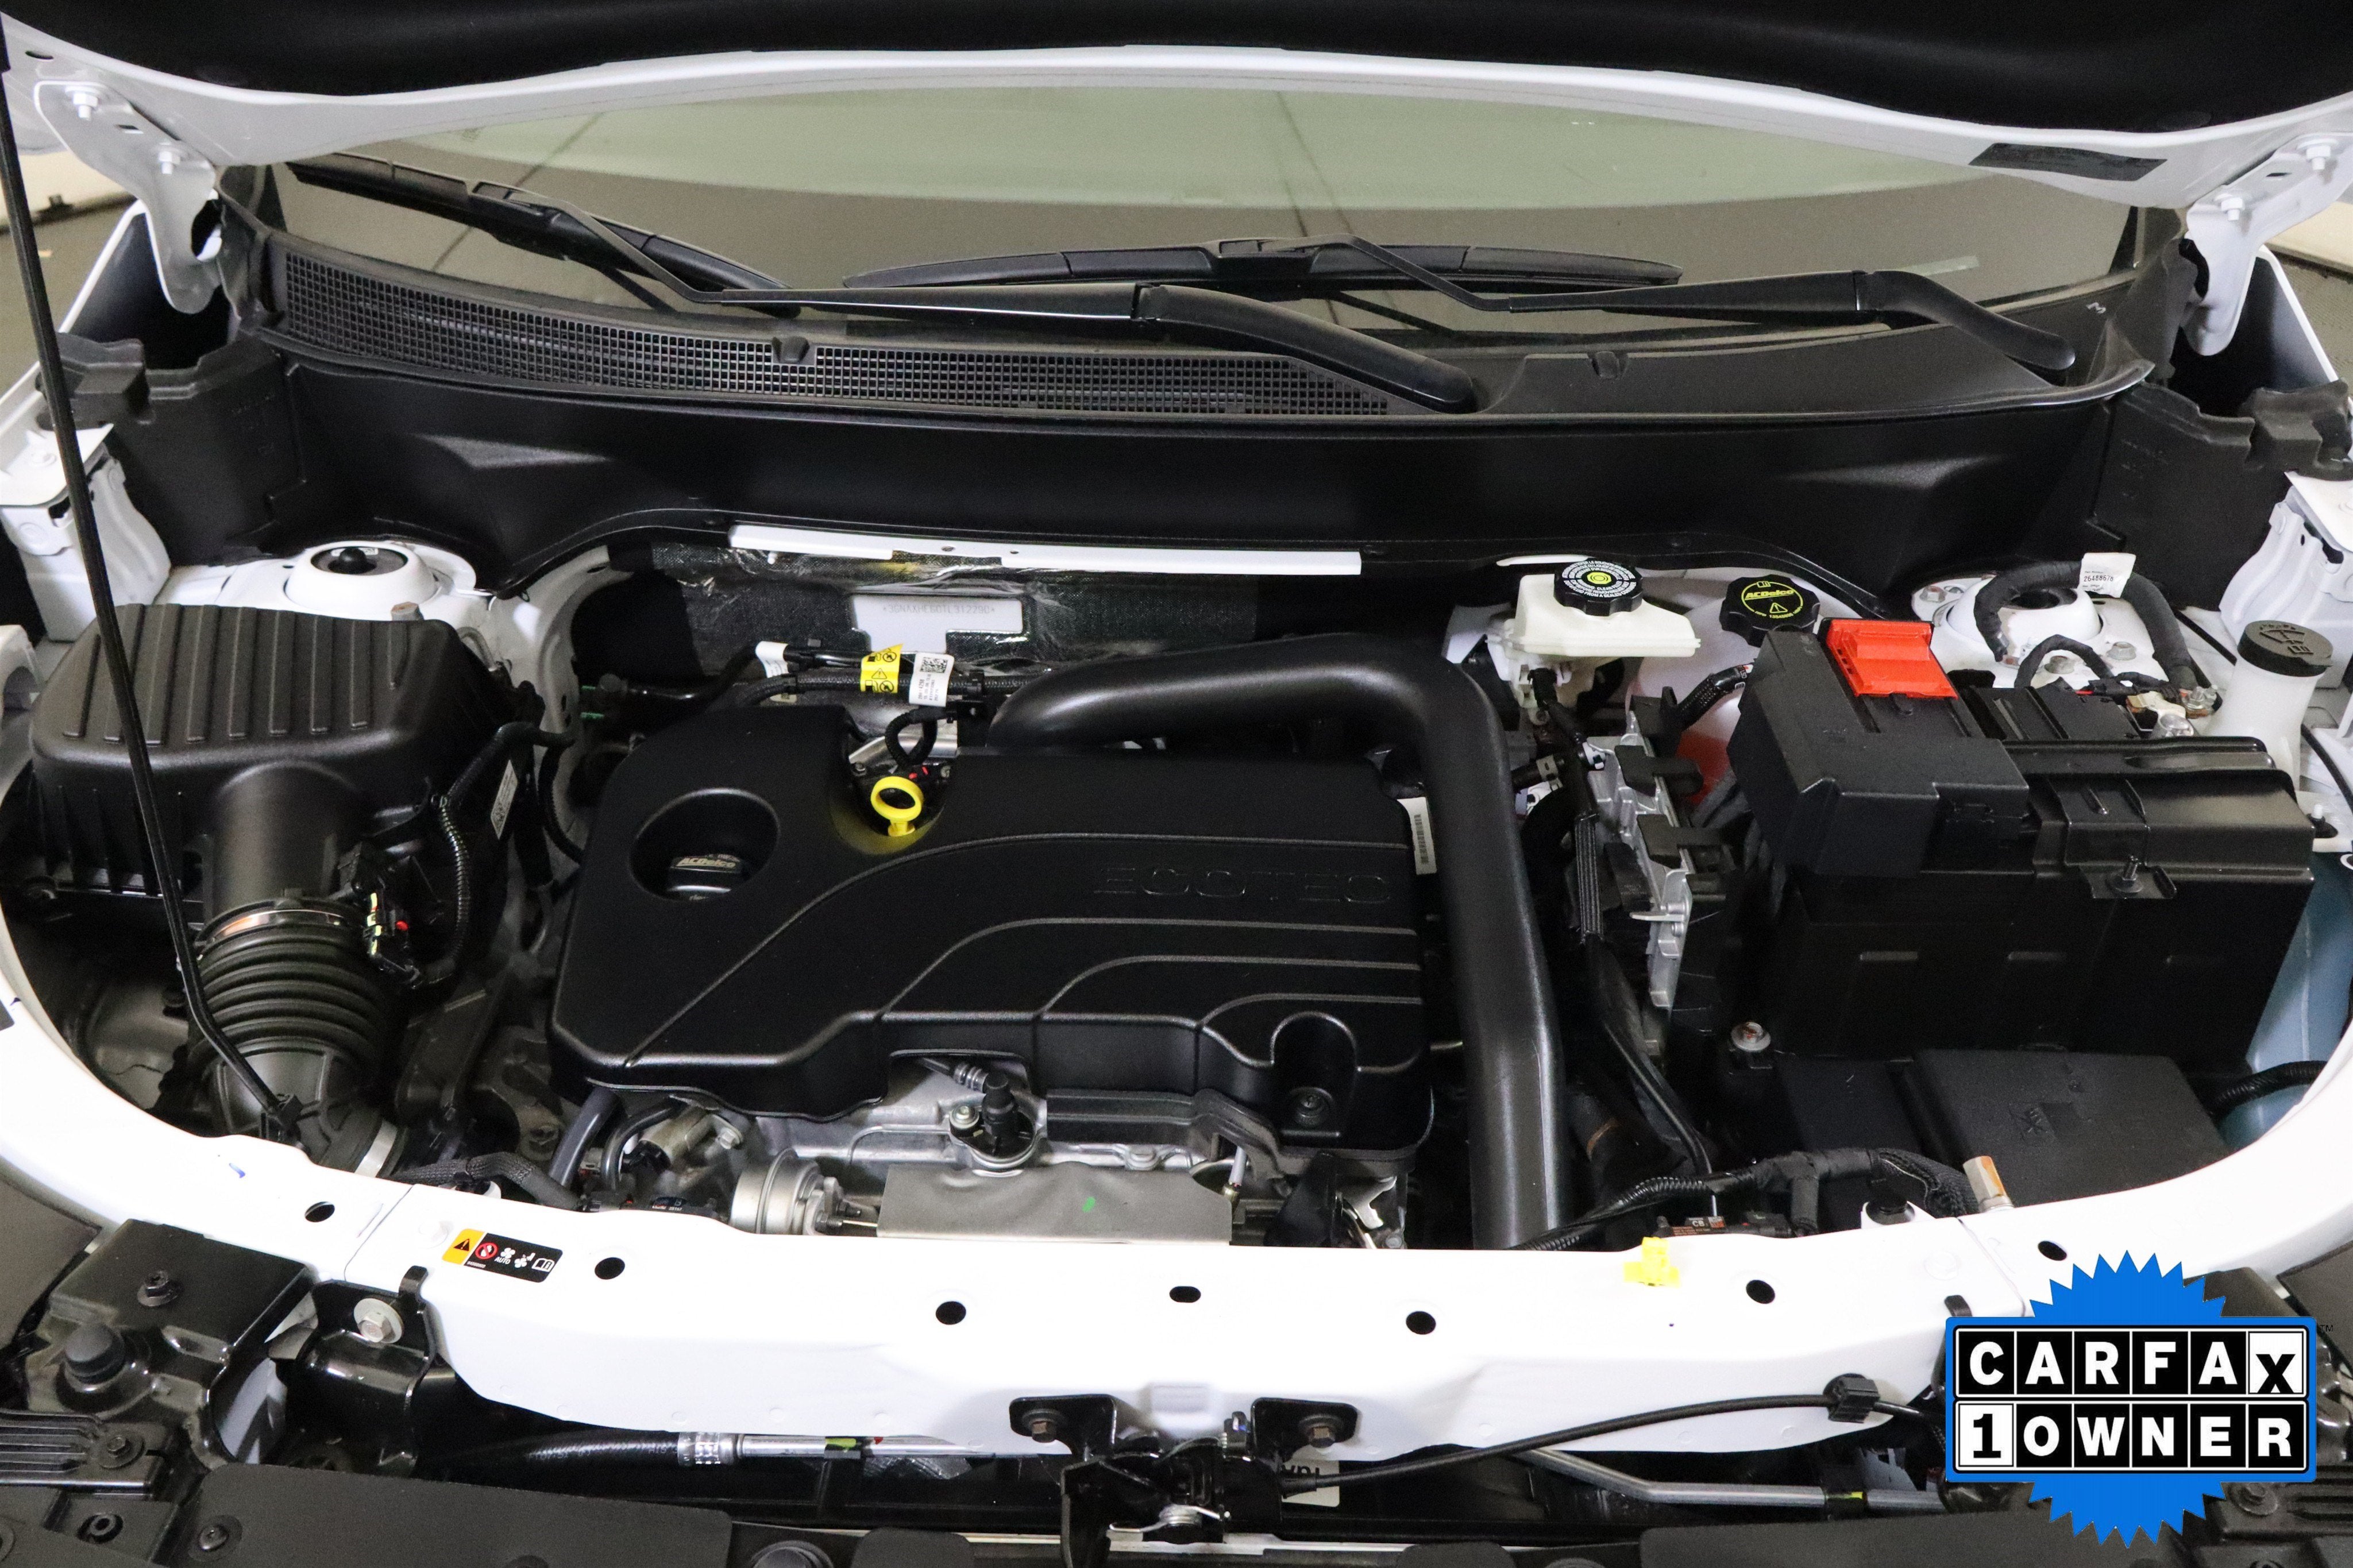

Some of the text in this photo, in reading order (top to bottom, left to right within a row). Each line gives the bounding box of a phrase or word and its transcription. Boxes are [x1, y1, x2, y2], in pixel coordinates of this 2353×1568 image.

[1745, 589, 1795, 600] ACDelco
[676, 858, 736, 868] ACDelco
[1093, 867, 1391, 904] ECOTEC
[494, 1256, 511, 1265] AUTO
